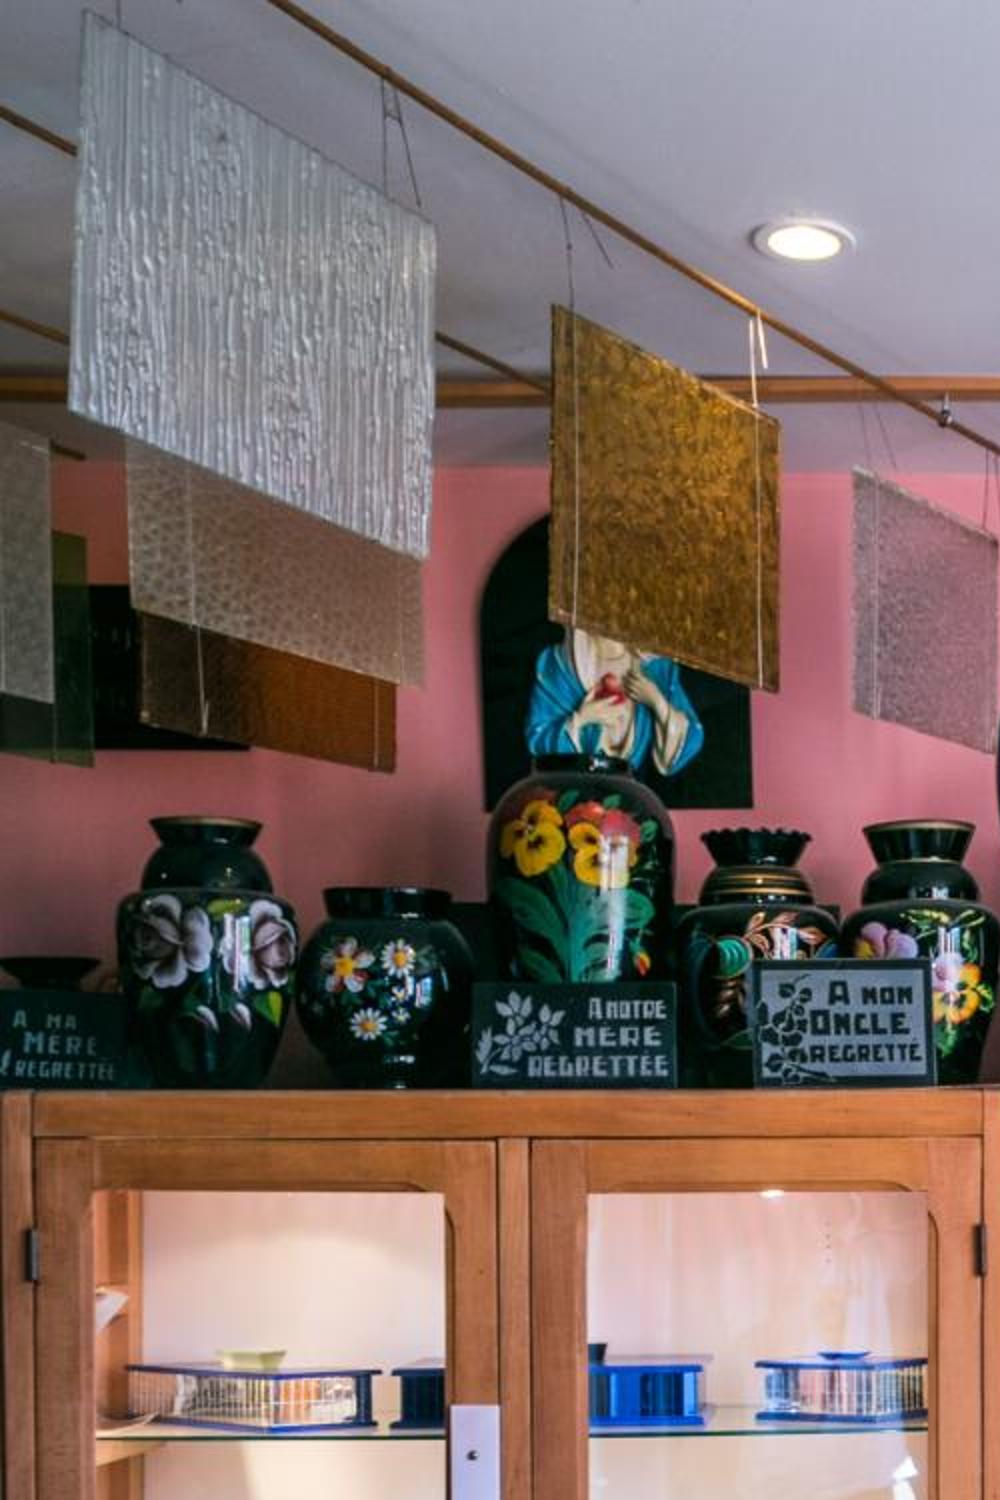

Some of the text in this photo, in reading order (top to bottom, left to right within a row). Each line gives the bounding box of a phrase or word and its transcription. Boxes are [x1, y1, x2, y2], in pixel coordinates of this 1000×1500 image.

[828, 980, 913, 1006] A MON
[12, 1008, 77, 1030] A MA
[588, 997, 668, 1020] A NOTRE
[810, 1009, 911, 1036] ONCLE
[809, 1037, 923, 1064] REGRETTÉ
[527, 1050, 670, 1079] REGRETTÉE
